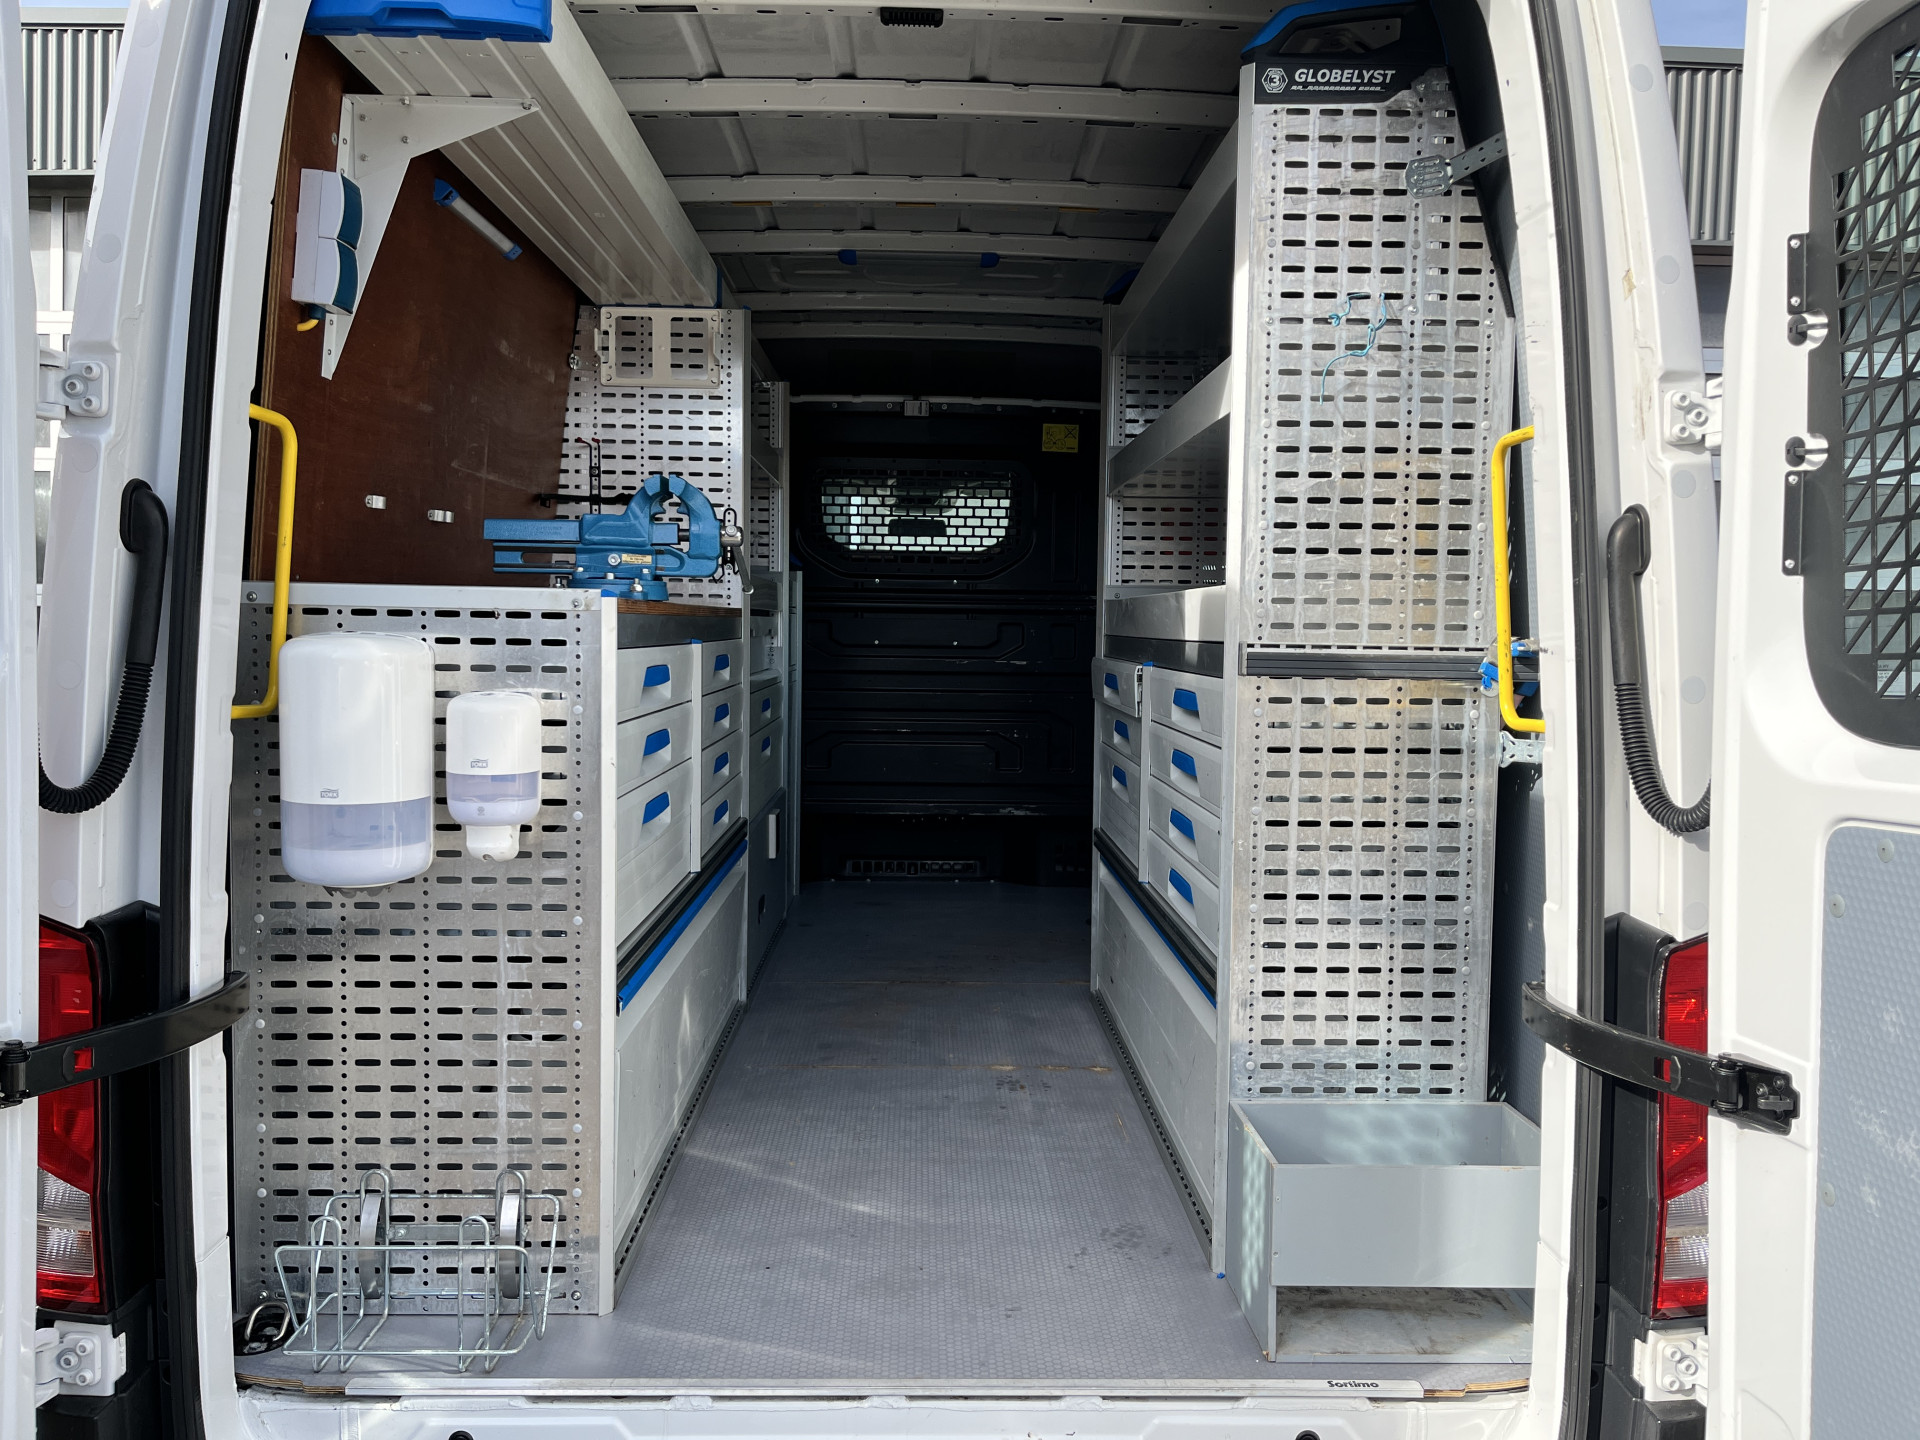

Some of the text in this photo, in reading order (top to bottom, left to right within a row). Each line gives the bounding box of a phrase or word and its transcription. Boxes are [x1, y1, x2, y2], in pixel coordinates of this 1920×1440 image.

[1270, 75, 1280, 86] 3
[1294, 68, 1396, 84] GLOBELYST
[1327, 1380, 1379, 1388] Sortimo
